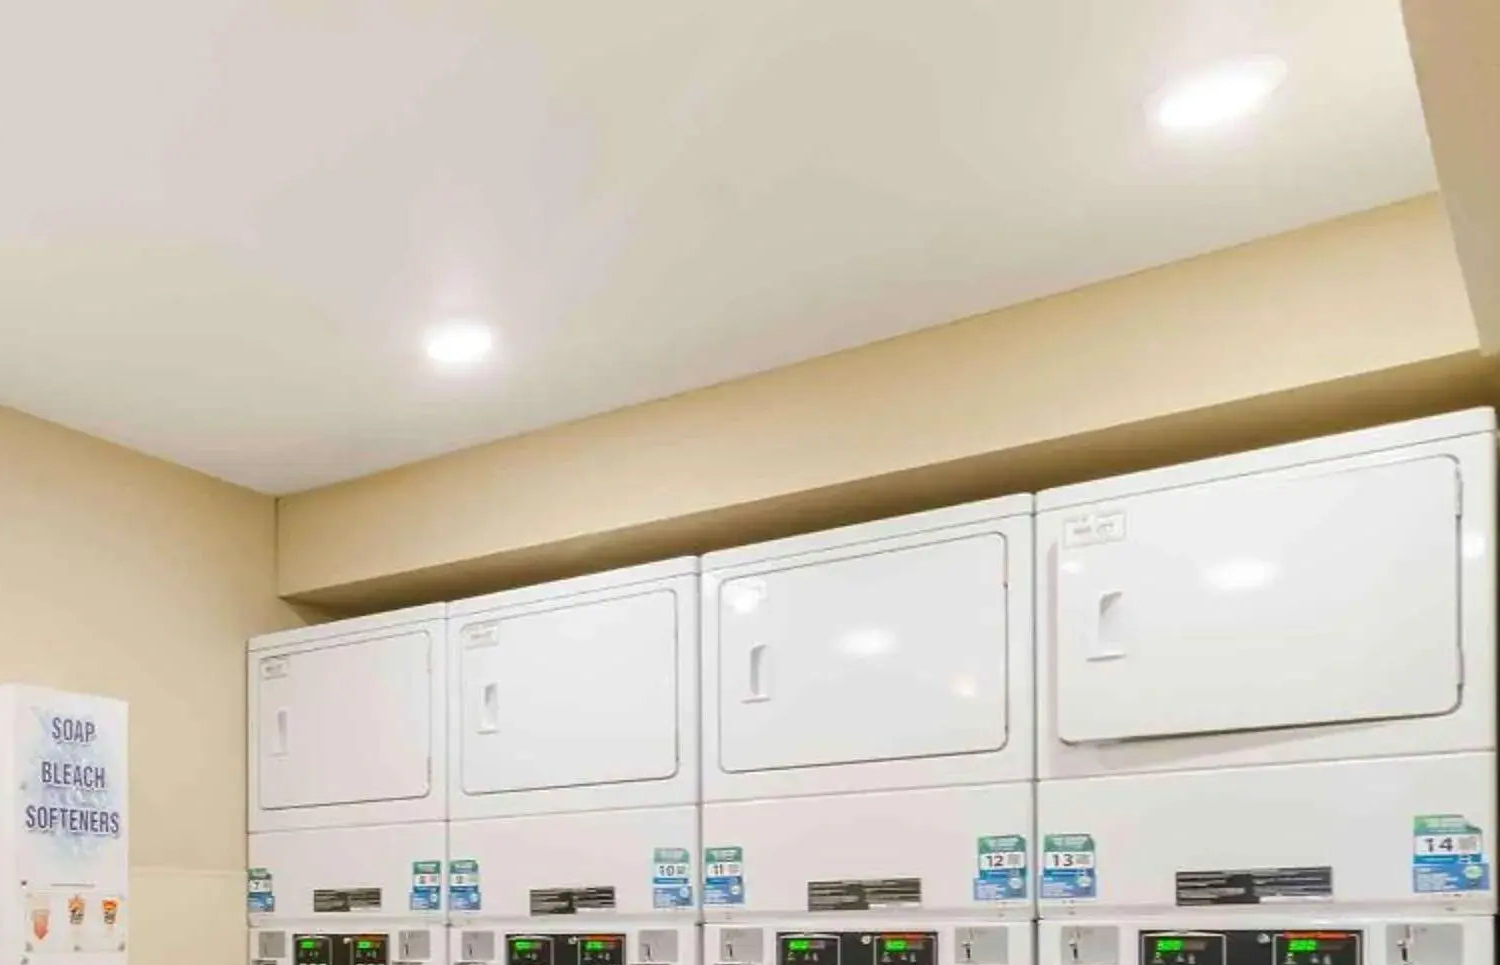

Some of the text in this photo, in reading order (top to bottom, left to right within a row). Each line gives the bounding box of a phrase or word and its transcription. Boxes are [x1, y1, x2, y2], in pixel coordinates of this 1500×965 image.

[51, 717, 96, 743] SOAP
[41, 761, 106, 789] BLEACH
[25, 804, 120, 834] SOFTENERS
[1424, 837, 1453, 852] 14
[985, 855, 1004, 867] 12
[1052, 854, 1074, 867] 13
[659, 865, 675, 876] 10
